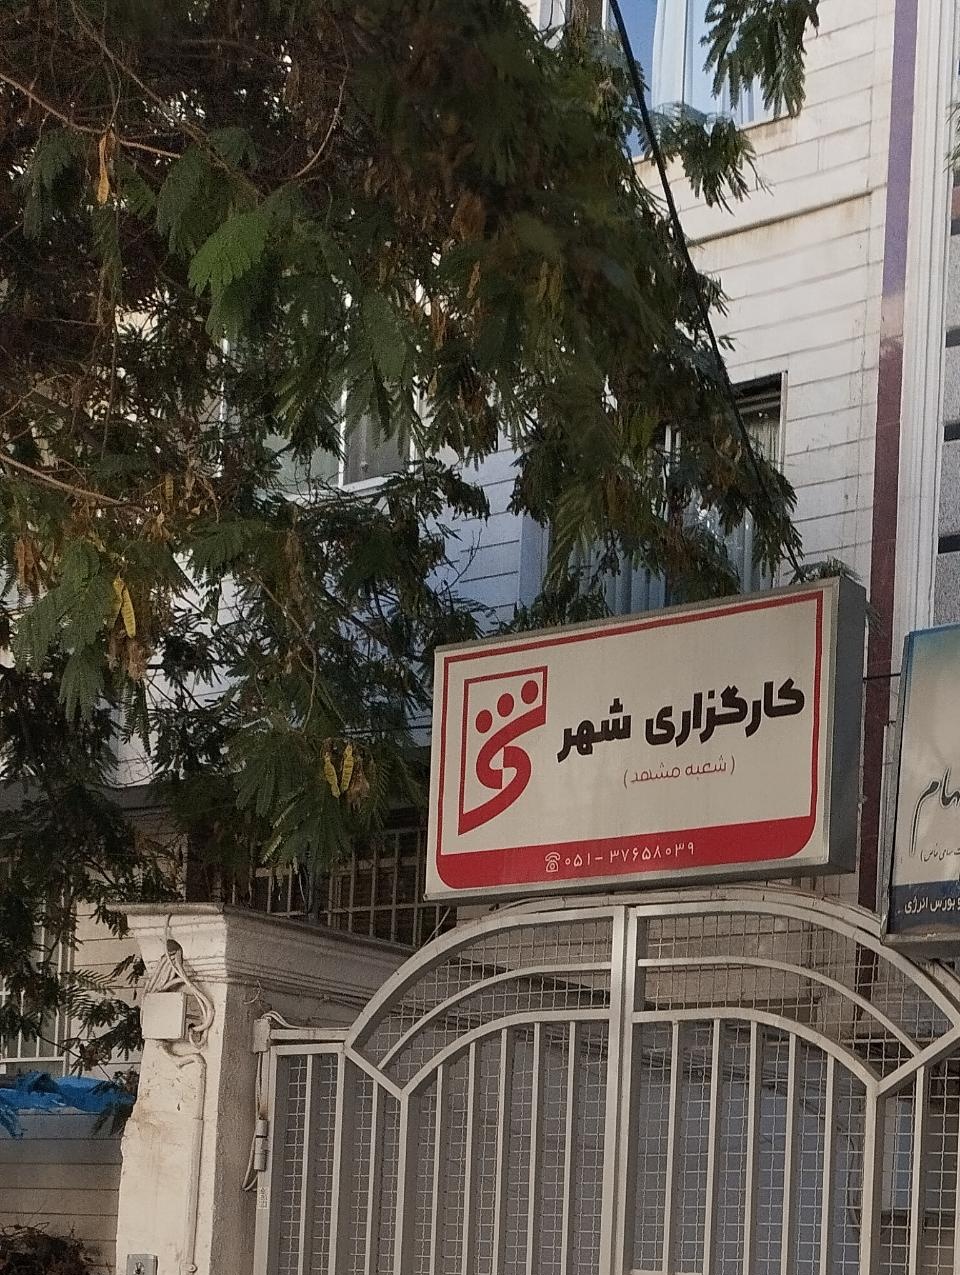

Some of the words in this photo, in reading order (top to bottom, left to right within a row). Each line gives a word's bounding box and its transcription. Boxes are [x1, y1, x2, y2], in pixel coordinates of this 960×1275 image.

[645, 678, 805, 747] کارگزاری
[557, 697, 632, 763] شهر
[609, 841, 695, 863] ۳۷۶۵۸۰۳۹
[903, 894, 929, 915] انرژی
[929, 894, 957, 913] بورس
